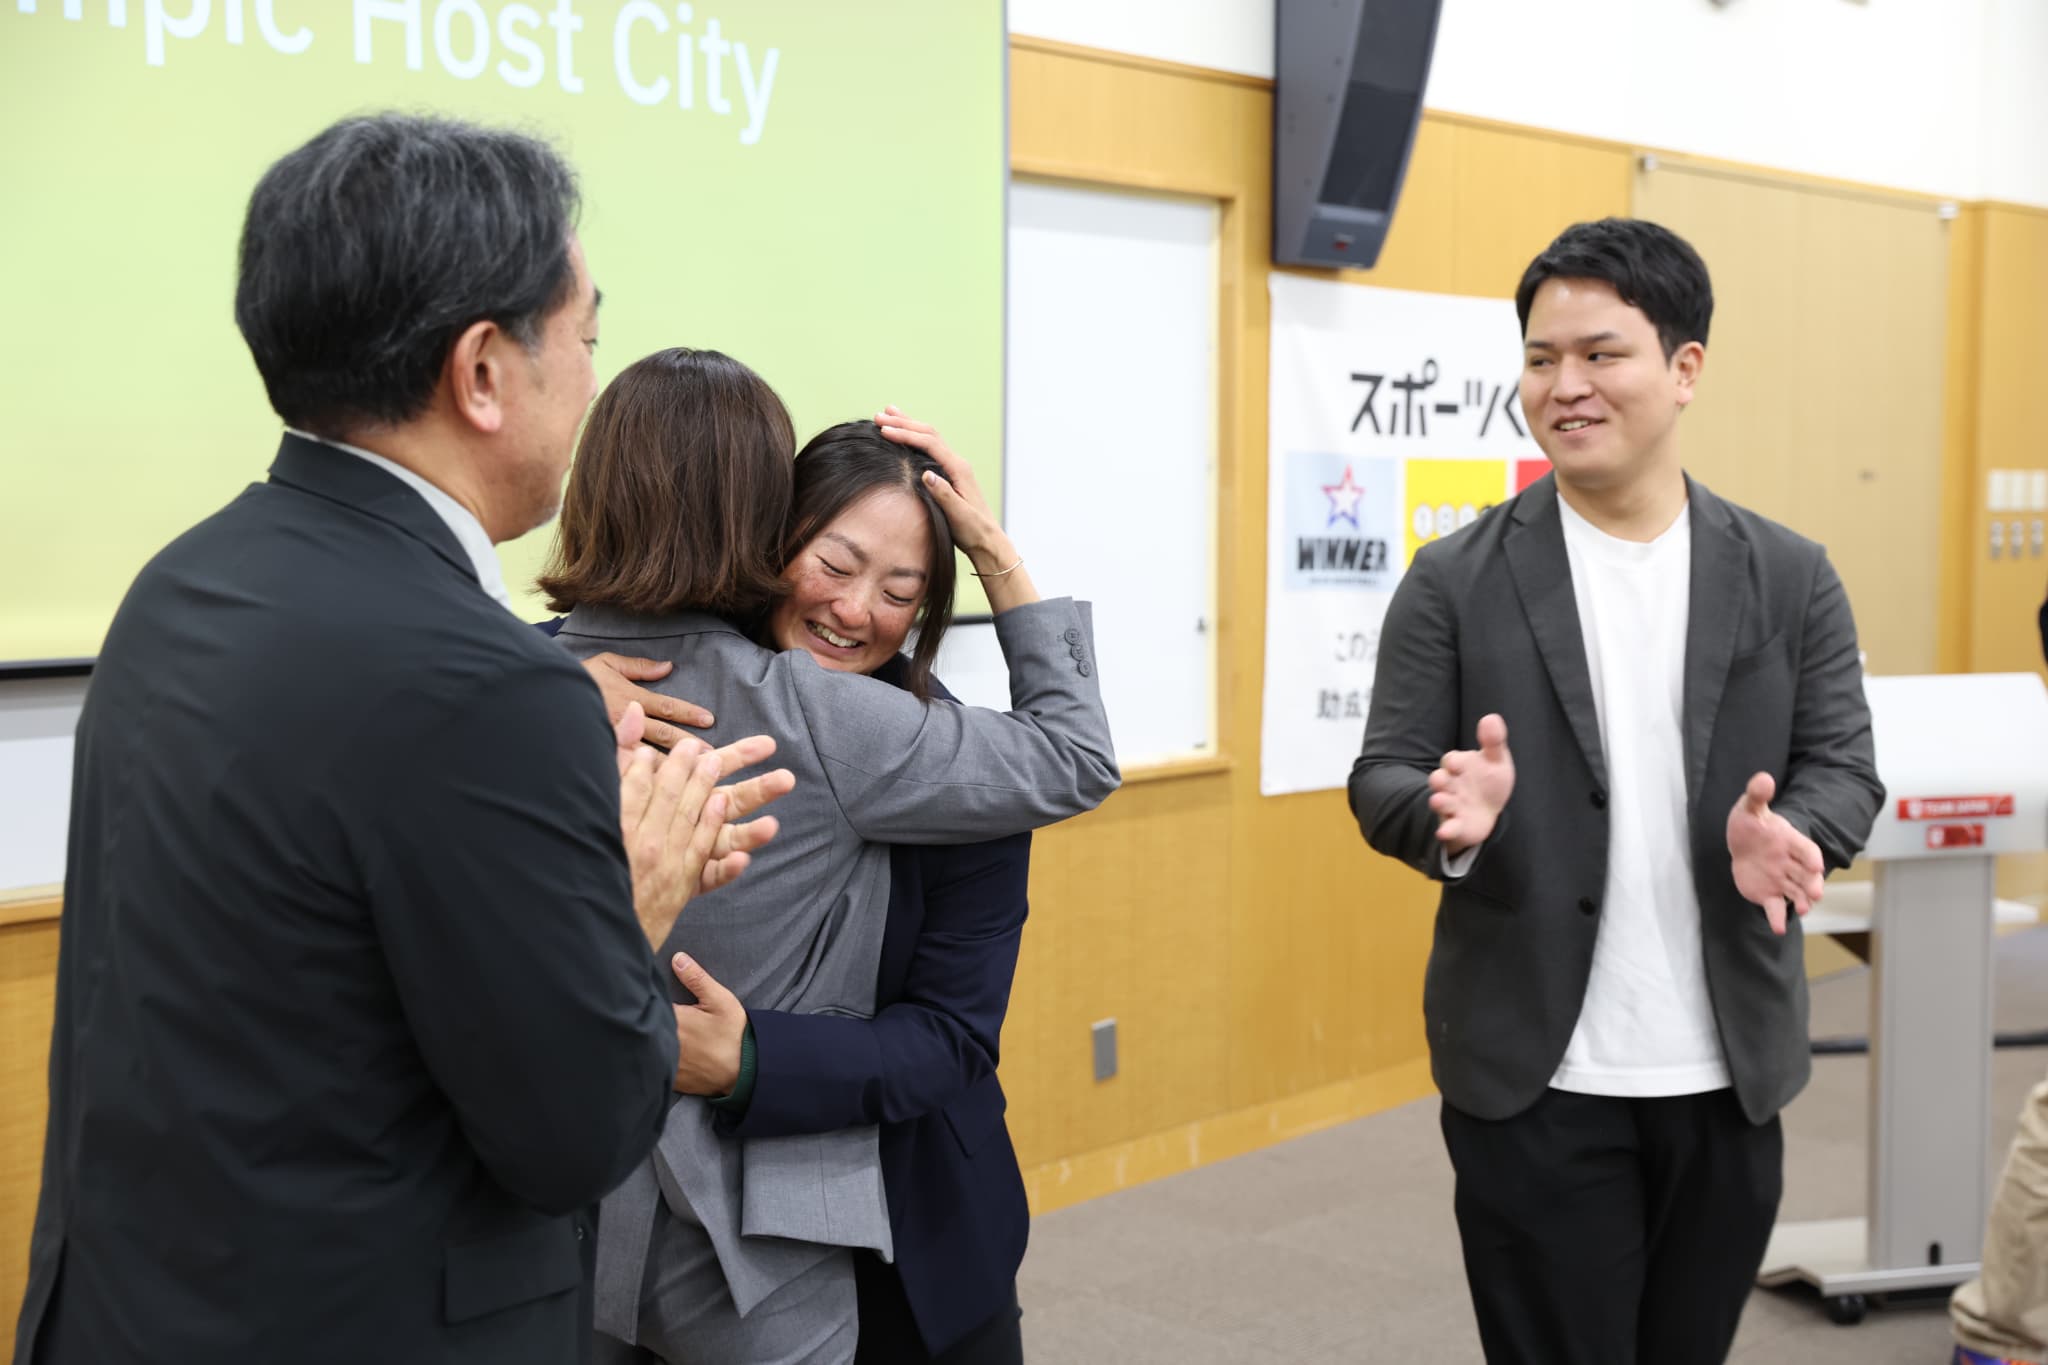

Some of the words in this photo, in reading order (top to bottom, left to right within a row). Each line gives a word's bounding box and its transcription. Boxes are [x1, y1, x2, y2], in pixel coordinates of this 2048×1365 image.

[18, 0, 314, 66] pic
[353, 0, 584, 93] Host
[613, 0, 780, 145] City
[1298, 537, 1388, 571] WINNER
